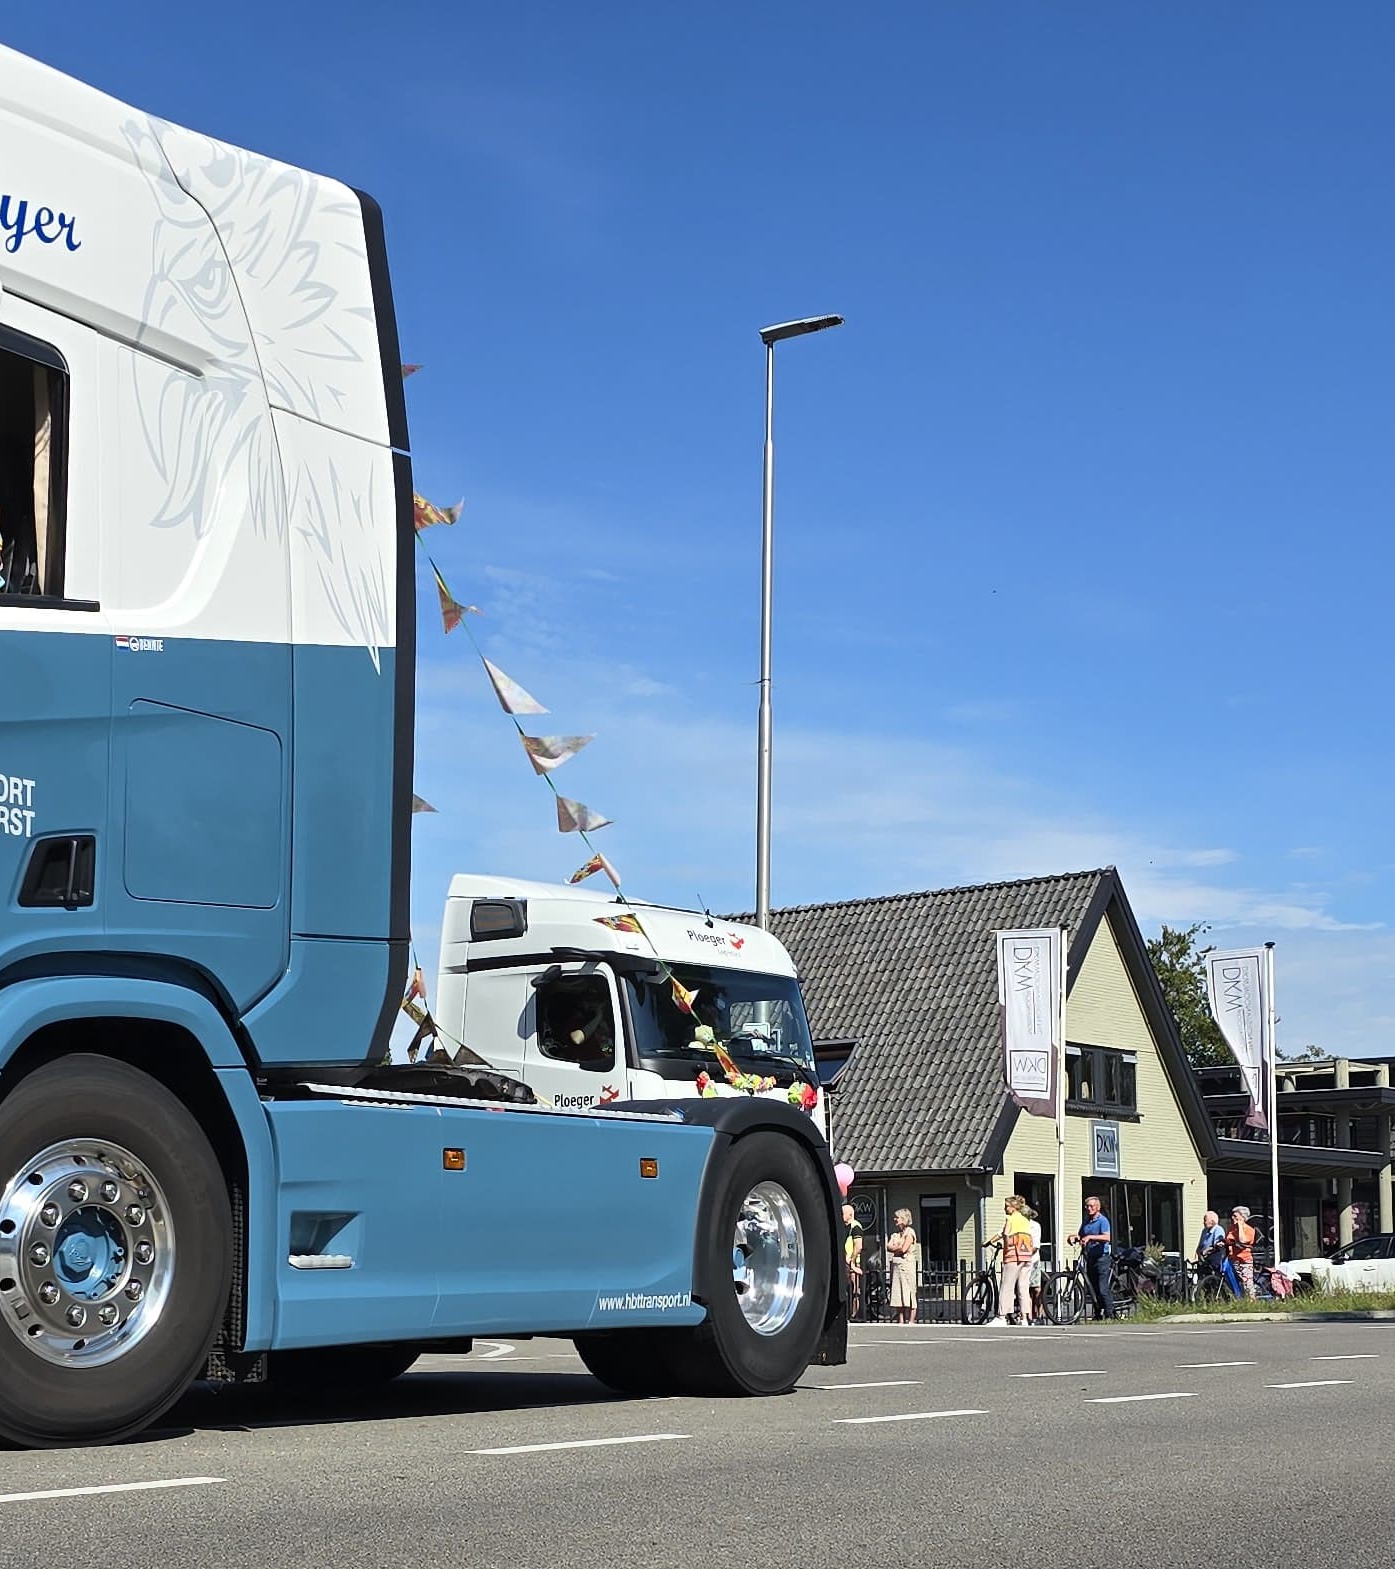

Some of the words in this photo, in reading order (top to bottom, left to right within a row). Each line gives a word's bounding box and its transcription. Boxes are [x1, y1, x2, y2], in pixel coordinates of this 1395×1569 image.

[686, 929, 726, 947] Ploeger
[554, 1093, 595, 1110] Ploeger
[598, 1289, 692, 1313] www.hbttransport.nl
